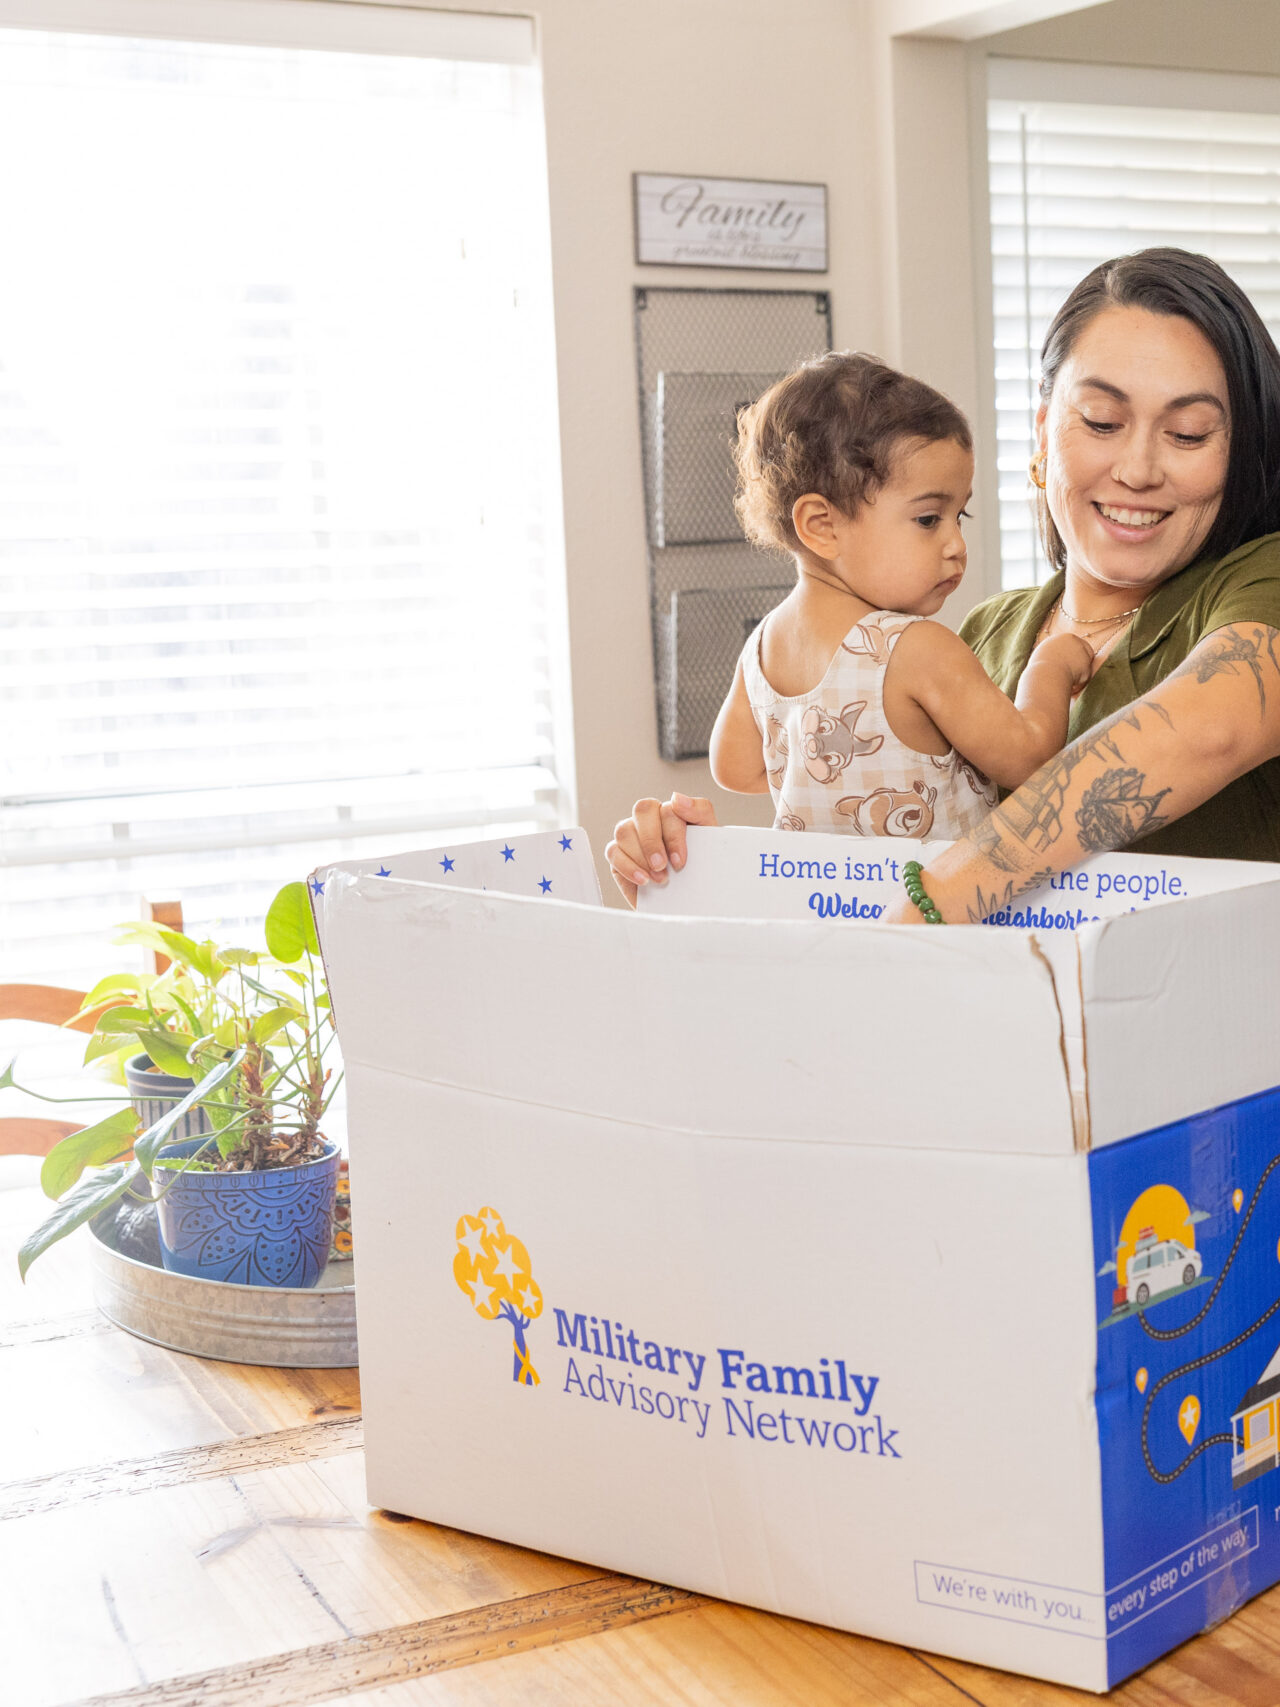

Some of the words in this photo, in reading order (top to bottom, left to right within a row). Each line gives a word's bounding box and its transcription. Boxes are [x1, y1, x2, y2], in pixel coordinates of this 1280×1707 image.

[660, 181, 808, 241] Family
[759, 853, 837, 879] Home
[844, 856, 899, 882] isn't
[1095, 870, 1188, 900] people.
[553, 1308, 706, 1391] Military
[717, 1348, 880, 1416] Family
[563, 1356, 711, 1438] Advisory
[722, 1397, 903, 1459] Network
[932, 1573, 987, 1601] We're
[992, 1587, 1037, 1612] with
[1107, 1586, 1148, 1622] every
[1149, 1566, 1178, 1597] step
[1180, 1552, 1195, 1578] of
[1197, 1541, 1219, 1567] the
